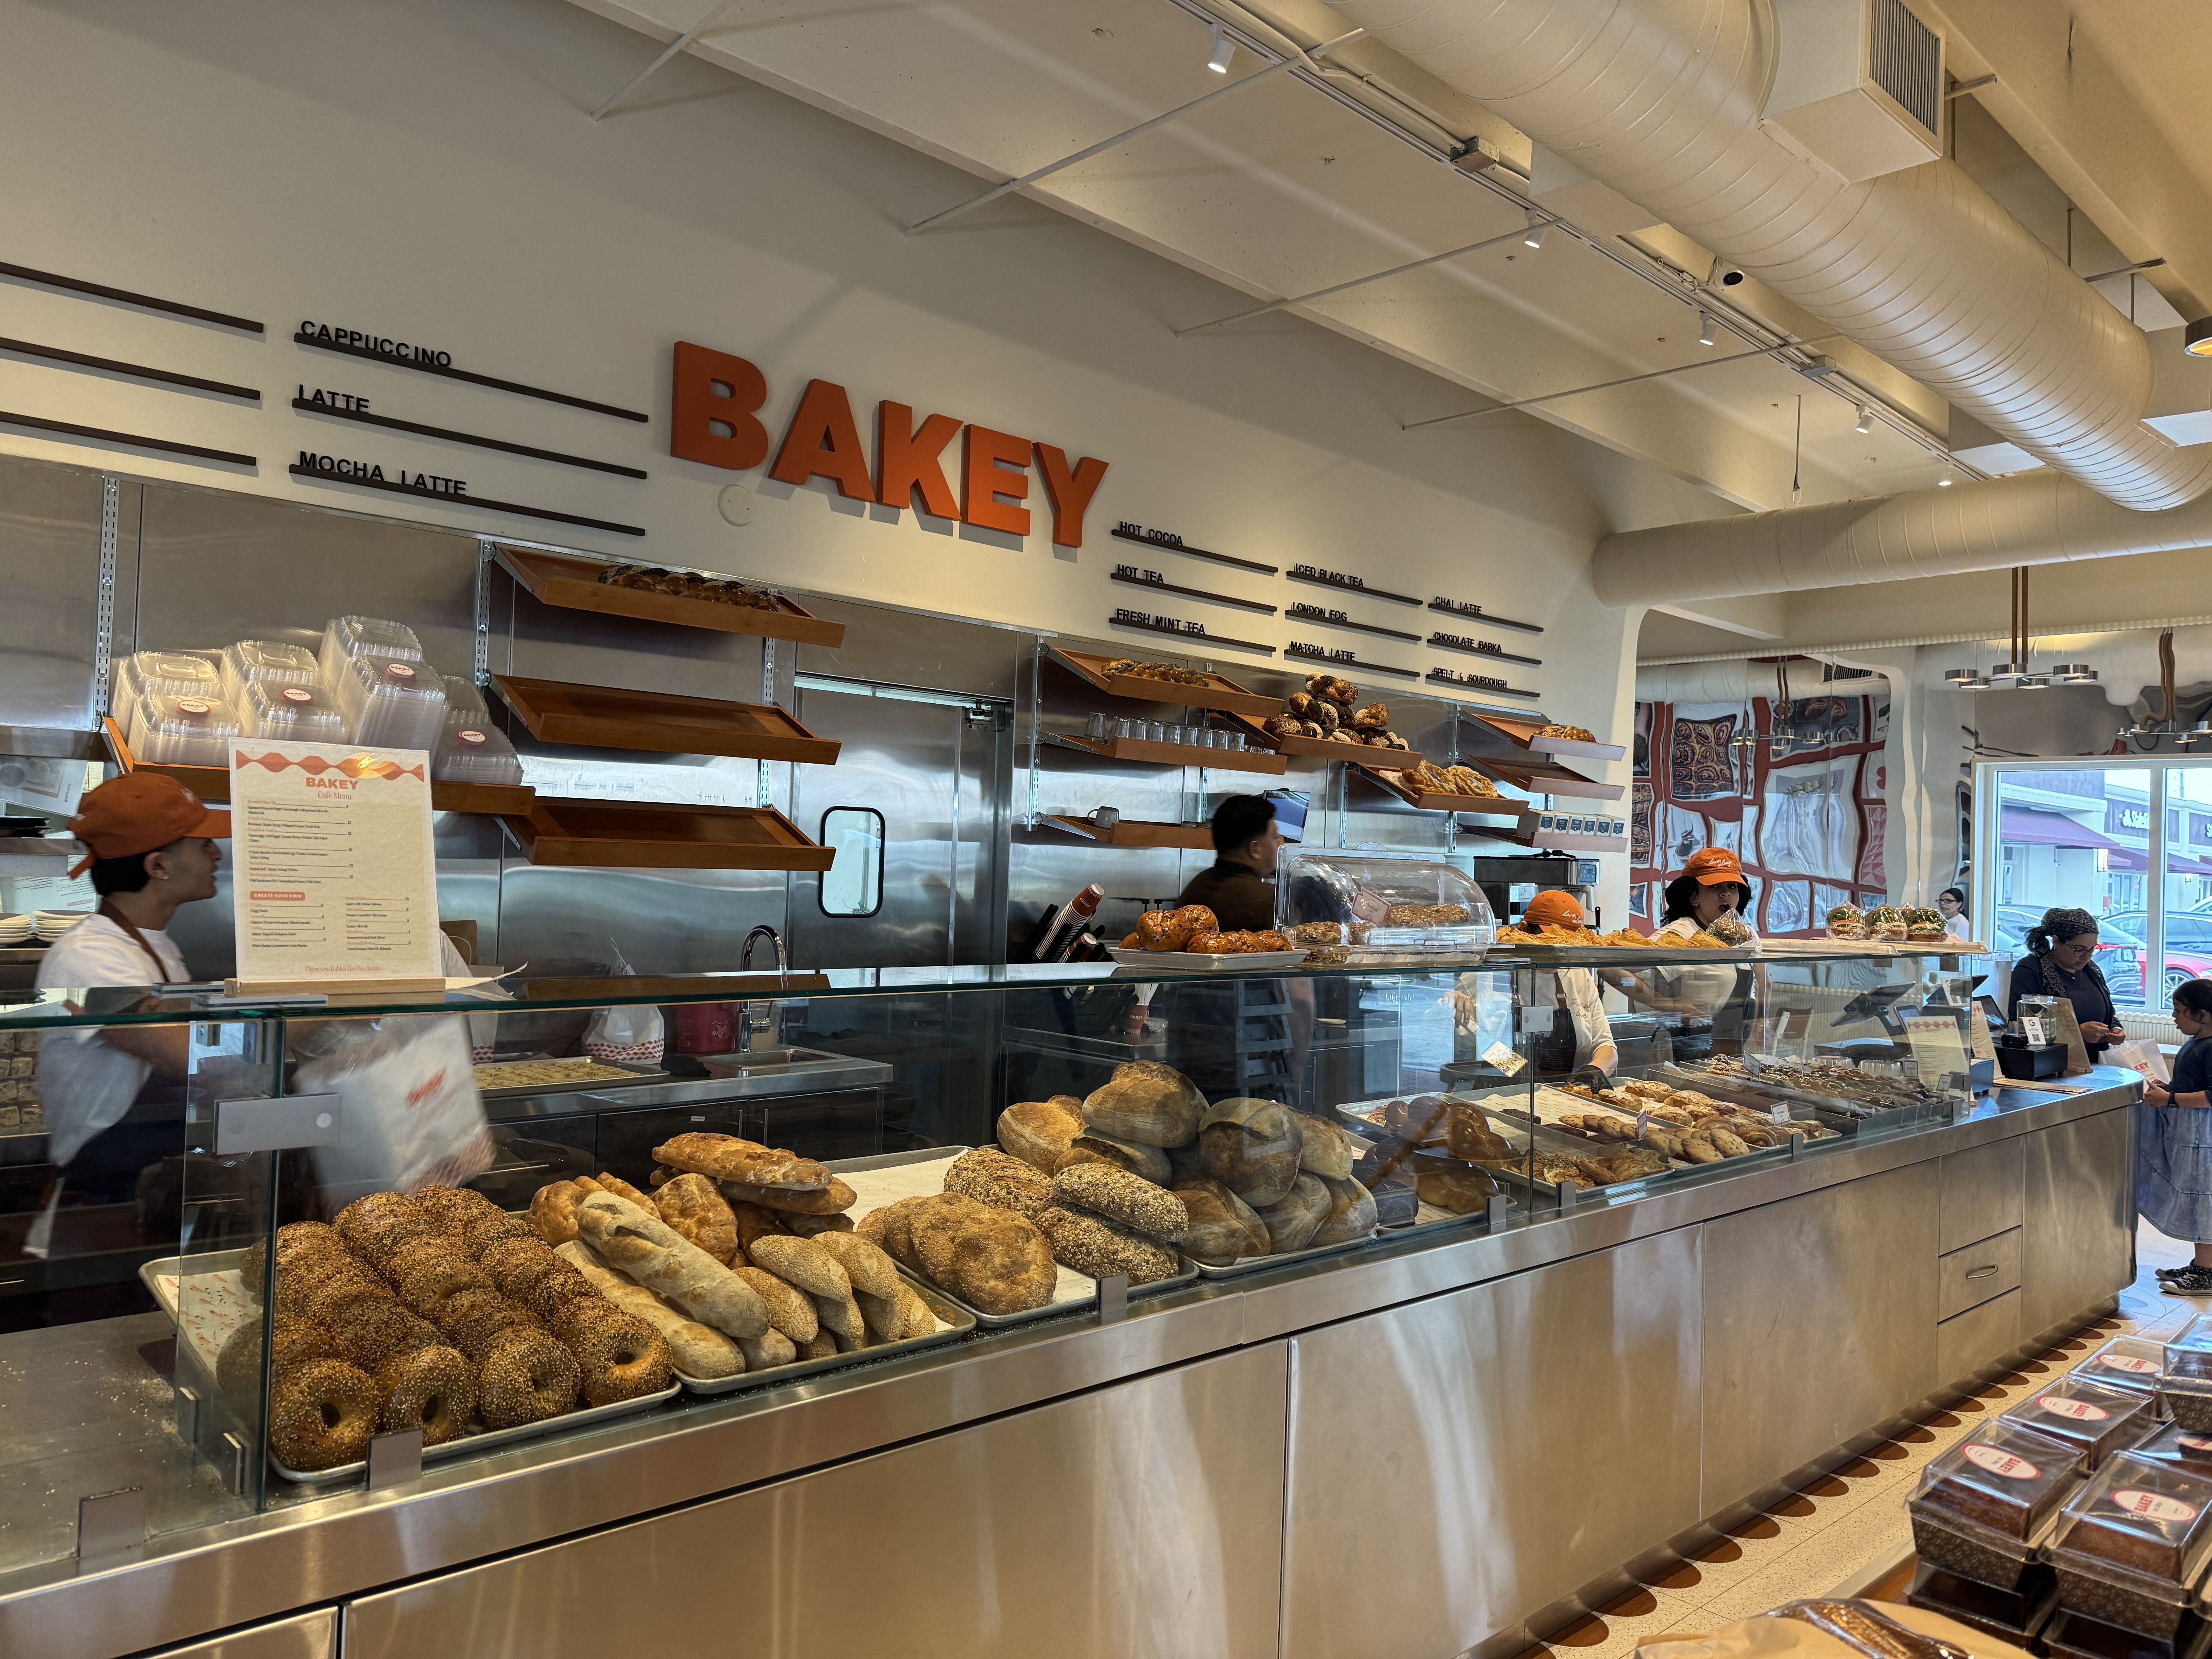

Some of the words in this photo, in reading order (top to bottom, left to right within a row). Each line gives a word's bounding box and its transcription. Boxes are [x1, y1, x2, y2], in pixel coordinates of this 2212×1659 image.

[301, 321, 451, 367] CAPPUCCINO
[299, 384, 369, 414] LATTE
[670, 340, 1109, 548] BAKEY
[300, 451, 385, 481] MOCHA
[401, 470, 466, 495] LATTE
[1120, 521, 1142, 536] HOT
[1148, 529, 1183, 546] COCOA
[1117, 564, 1138, 578] HOT
[1144, 570, 1164, 584] TEA
[1295, 563, 1316, 576] ICED
[1319, 569, 1346, 584] BLACK
[1348, 575, 1364, 587] TEA
[1293, 602, 1326, 617] LONDON
[1330, 610, 1347, 621] FOG
[1435, 597, 1454, 608] CHAI
[1460, 601, 1482, 614] LATTE
[1117, 608, 1150, 624] FRESH
[1155, 615, 1181, 630] MINT
[1186, 621, 1205, 634] TEA
[1291, 641, 1325, 656] MATCHA
[1331, 648, 1355, 661] LATTE
[1434, 632, 1474, 647] CHOCOLATE
[1479, 641, 1502, 653] BABKA
[1434, 667, 1454, 678] SPELT
[1459, 672, 1463, 681] &
[1468, 674, 1507, 688] SOURDOUGH
[306, 777, 359, 790] BAKEY
[1080, 897, 1091, 908] BAKEY
[2133, 1061, 2148, 1071] KEY
[2072, 1404, 2090, 1417] BAKEY
[1997, 1457, 2021, 1474] BAKEY
[2133, 1494, 2155, 1513] BAKEY
